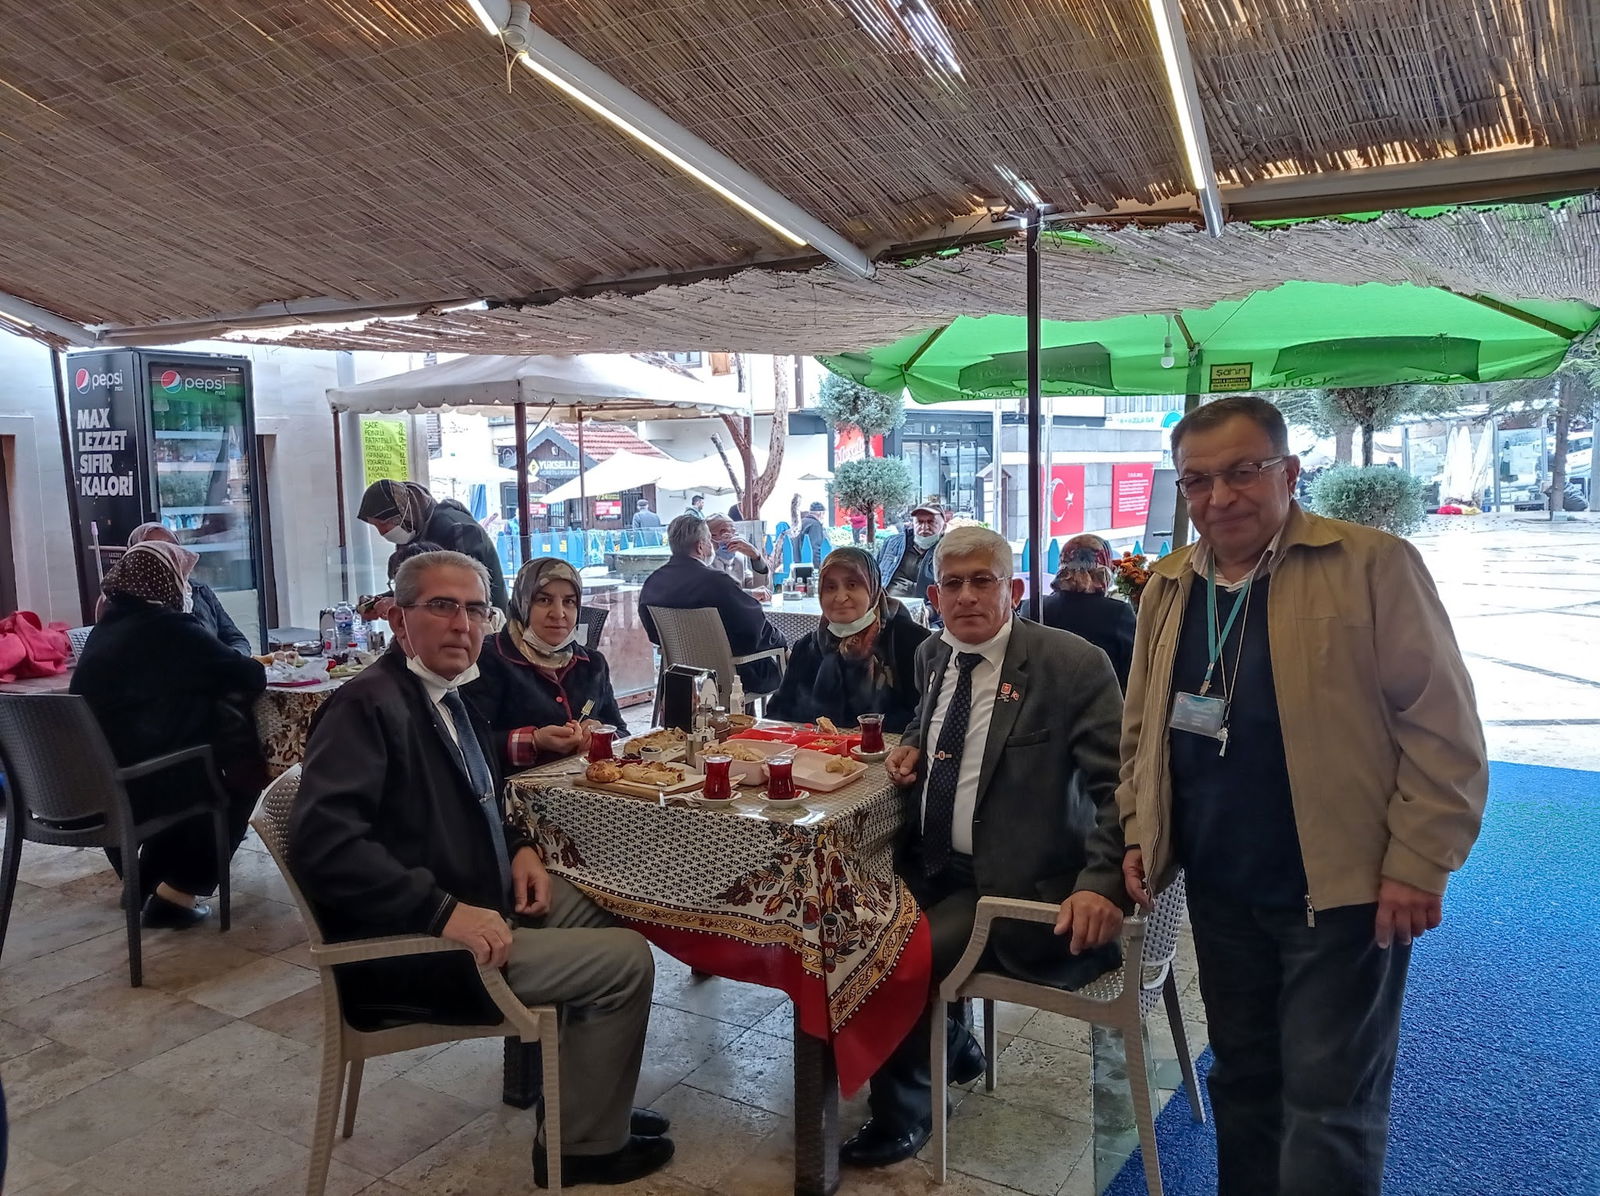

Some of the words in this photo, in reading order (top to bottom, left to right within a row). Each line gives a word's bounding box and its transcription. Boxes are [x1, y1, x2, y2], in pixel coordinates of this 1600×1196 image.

[91, 369, 123, 390] pepsi
[184, 377, 226, 392] pepsi
[77, 408, 110, 430] MAX
[78, 430, 127, 452] LEZZET
[80, 453, 113, 474] SIFIR
[81, 471, 134, 497] KALORİ
